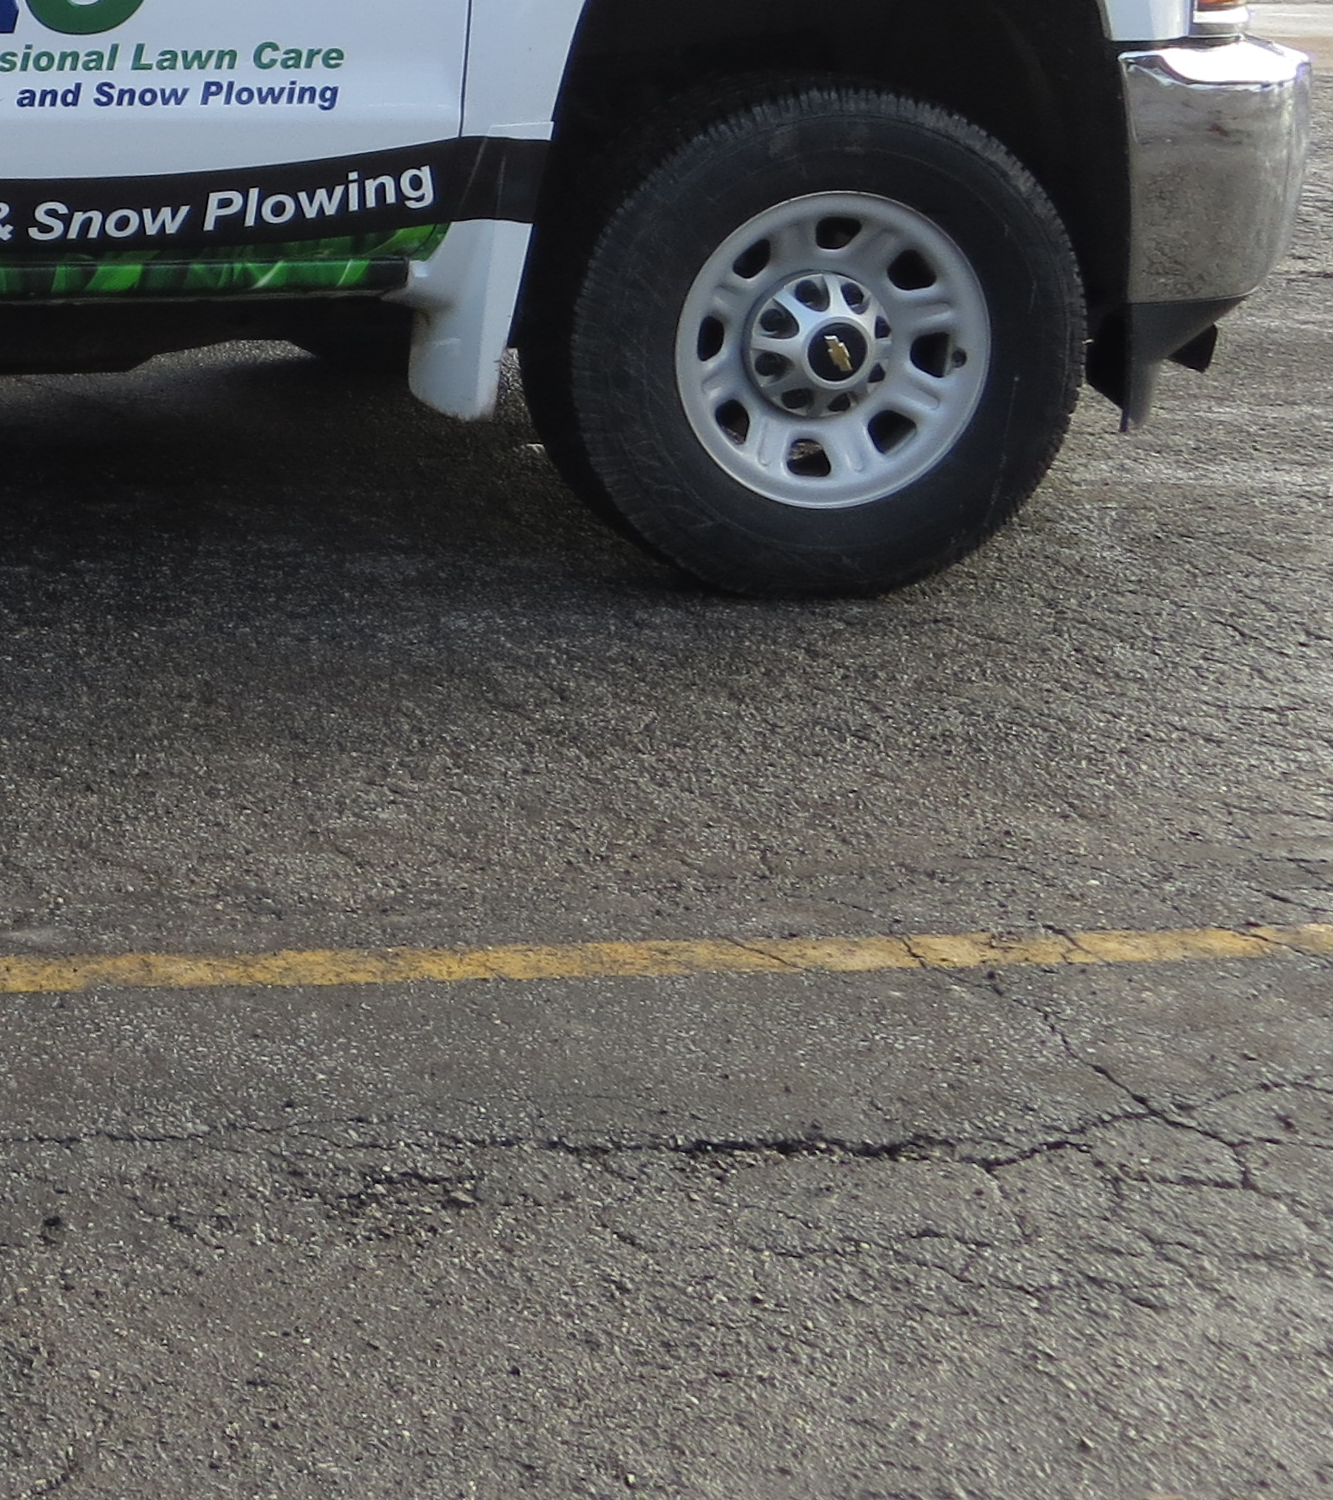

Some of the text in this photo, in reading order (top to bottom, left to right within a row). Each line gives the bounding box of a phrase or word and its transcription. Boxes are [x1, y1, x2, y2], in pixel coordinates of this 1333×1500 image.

[131, 43, 237, 71] Lawn
[252, 41, 345, 70] Care
[16, 81, 340, 111] and Snow Plowing
[27, 203, 190, 239] Snow
[203, 166, 435, 232] Plowing
